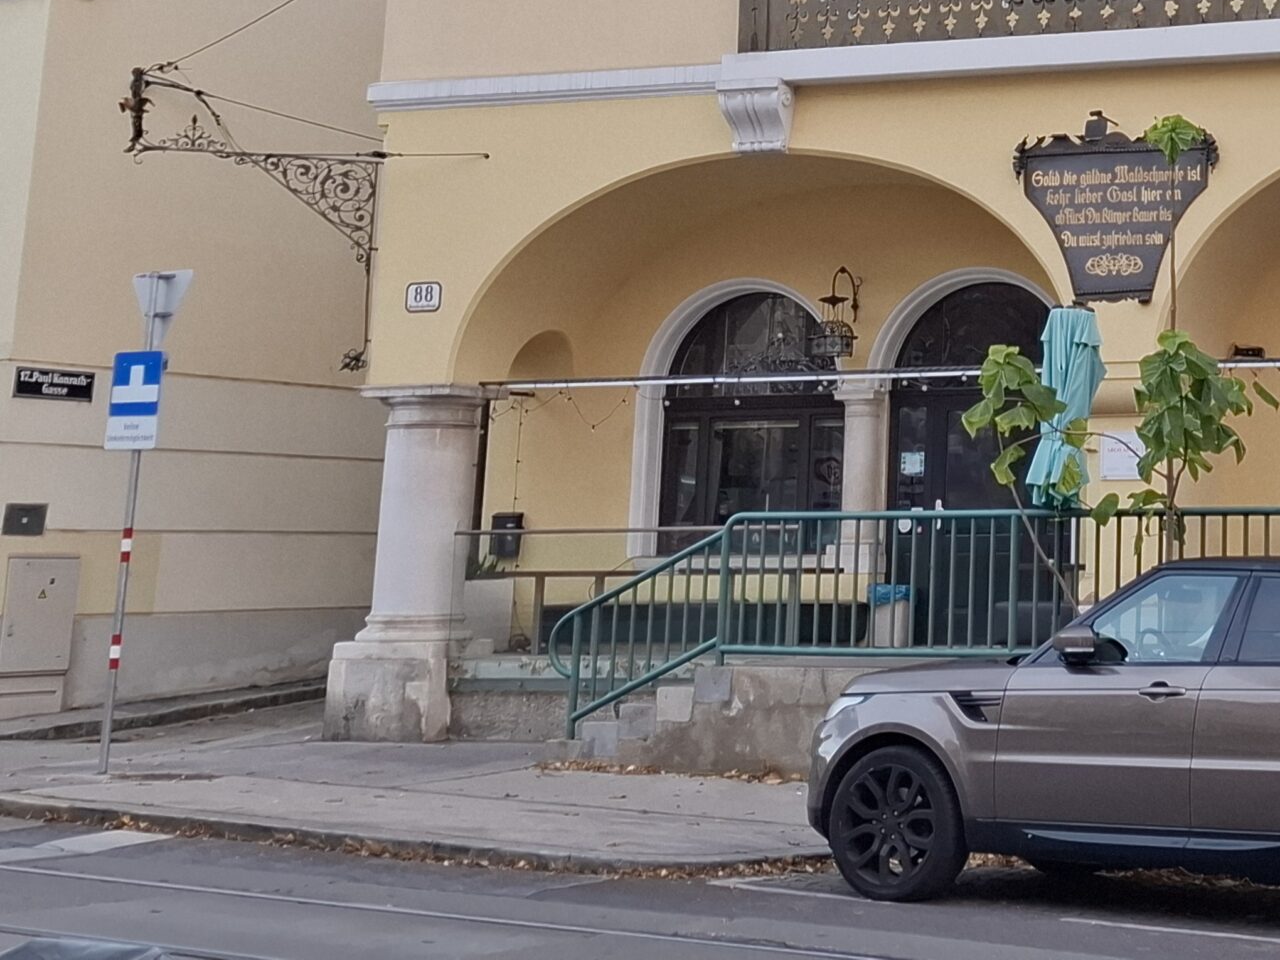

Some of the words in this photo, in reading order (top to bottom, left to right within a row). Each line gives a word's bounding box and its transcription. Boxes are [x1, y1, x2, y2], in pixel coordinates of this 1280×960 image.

[1063, 170, 1078, 186] die
[1080, 167, 1111, 187] güldne
[1187, 164, 1201, 182] ist
[1046, 188, 1071, 208] kehr
[1074, 187, 1103, 204] lieber
[1106, 185, 1137, 204] Gast
[1141, 185, 1161, 205] hier
[1166, 188, 1182, 201] en
[1055, 208, 1065, 224] ob
[1086, 207, 1101, 225] Du
[1132, 206, 1159, 222] Bauer
[1061, 231, 1077, 248] Du
[1079, 230, 1100, 247] wirst
[1101, 229, 1143, 249] zufrieden
[1145, 230, 1164, 246] sein
[414, 285, 434, 303] 88
[41, 383, 68, 395] Gasse
